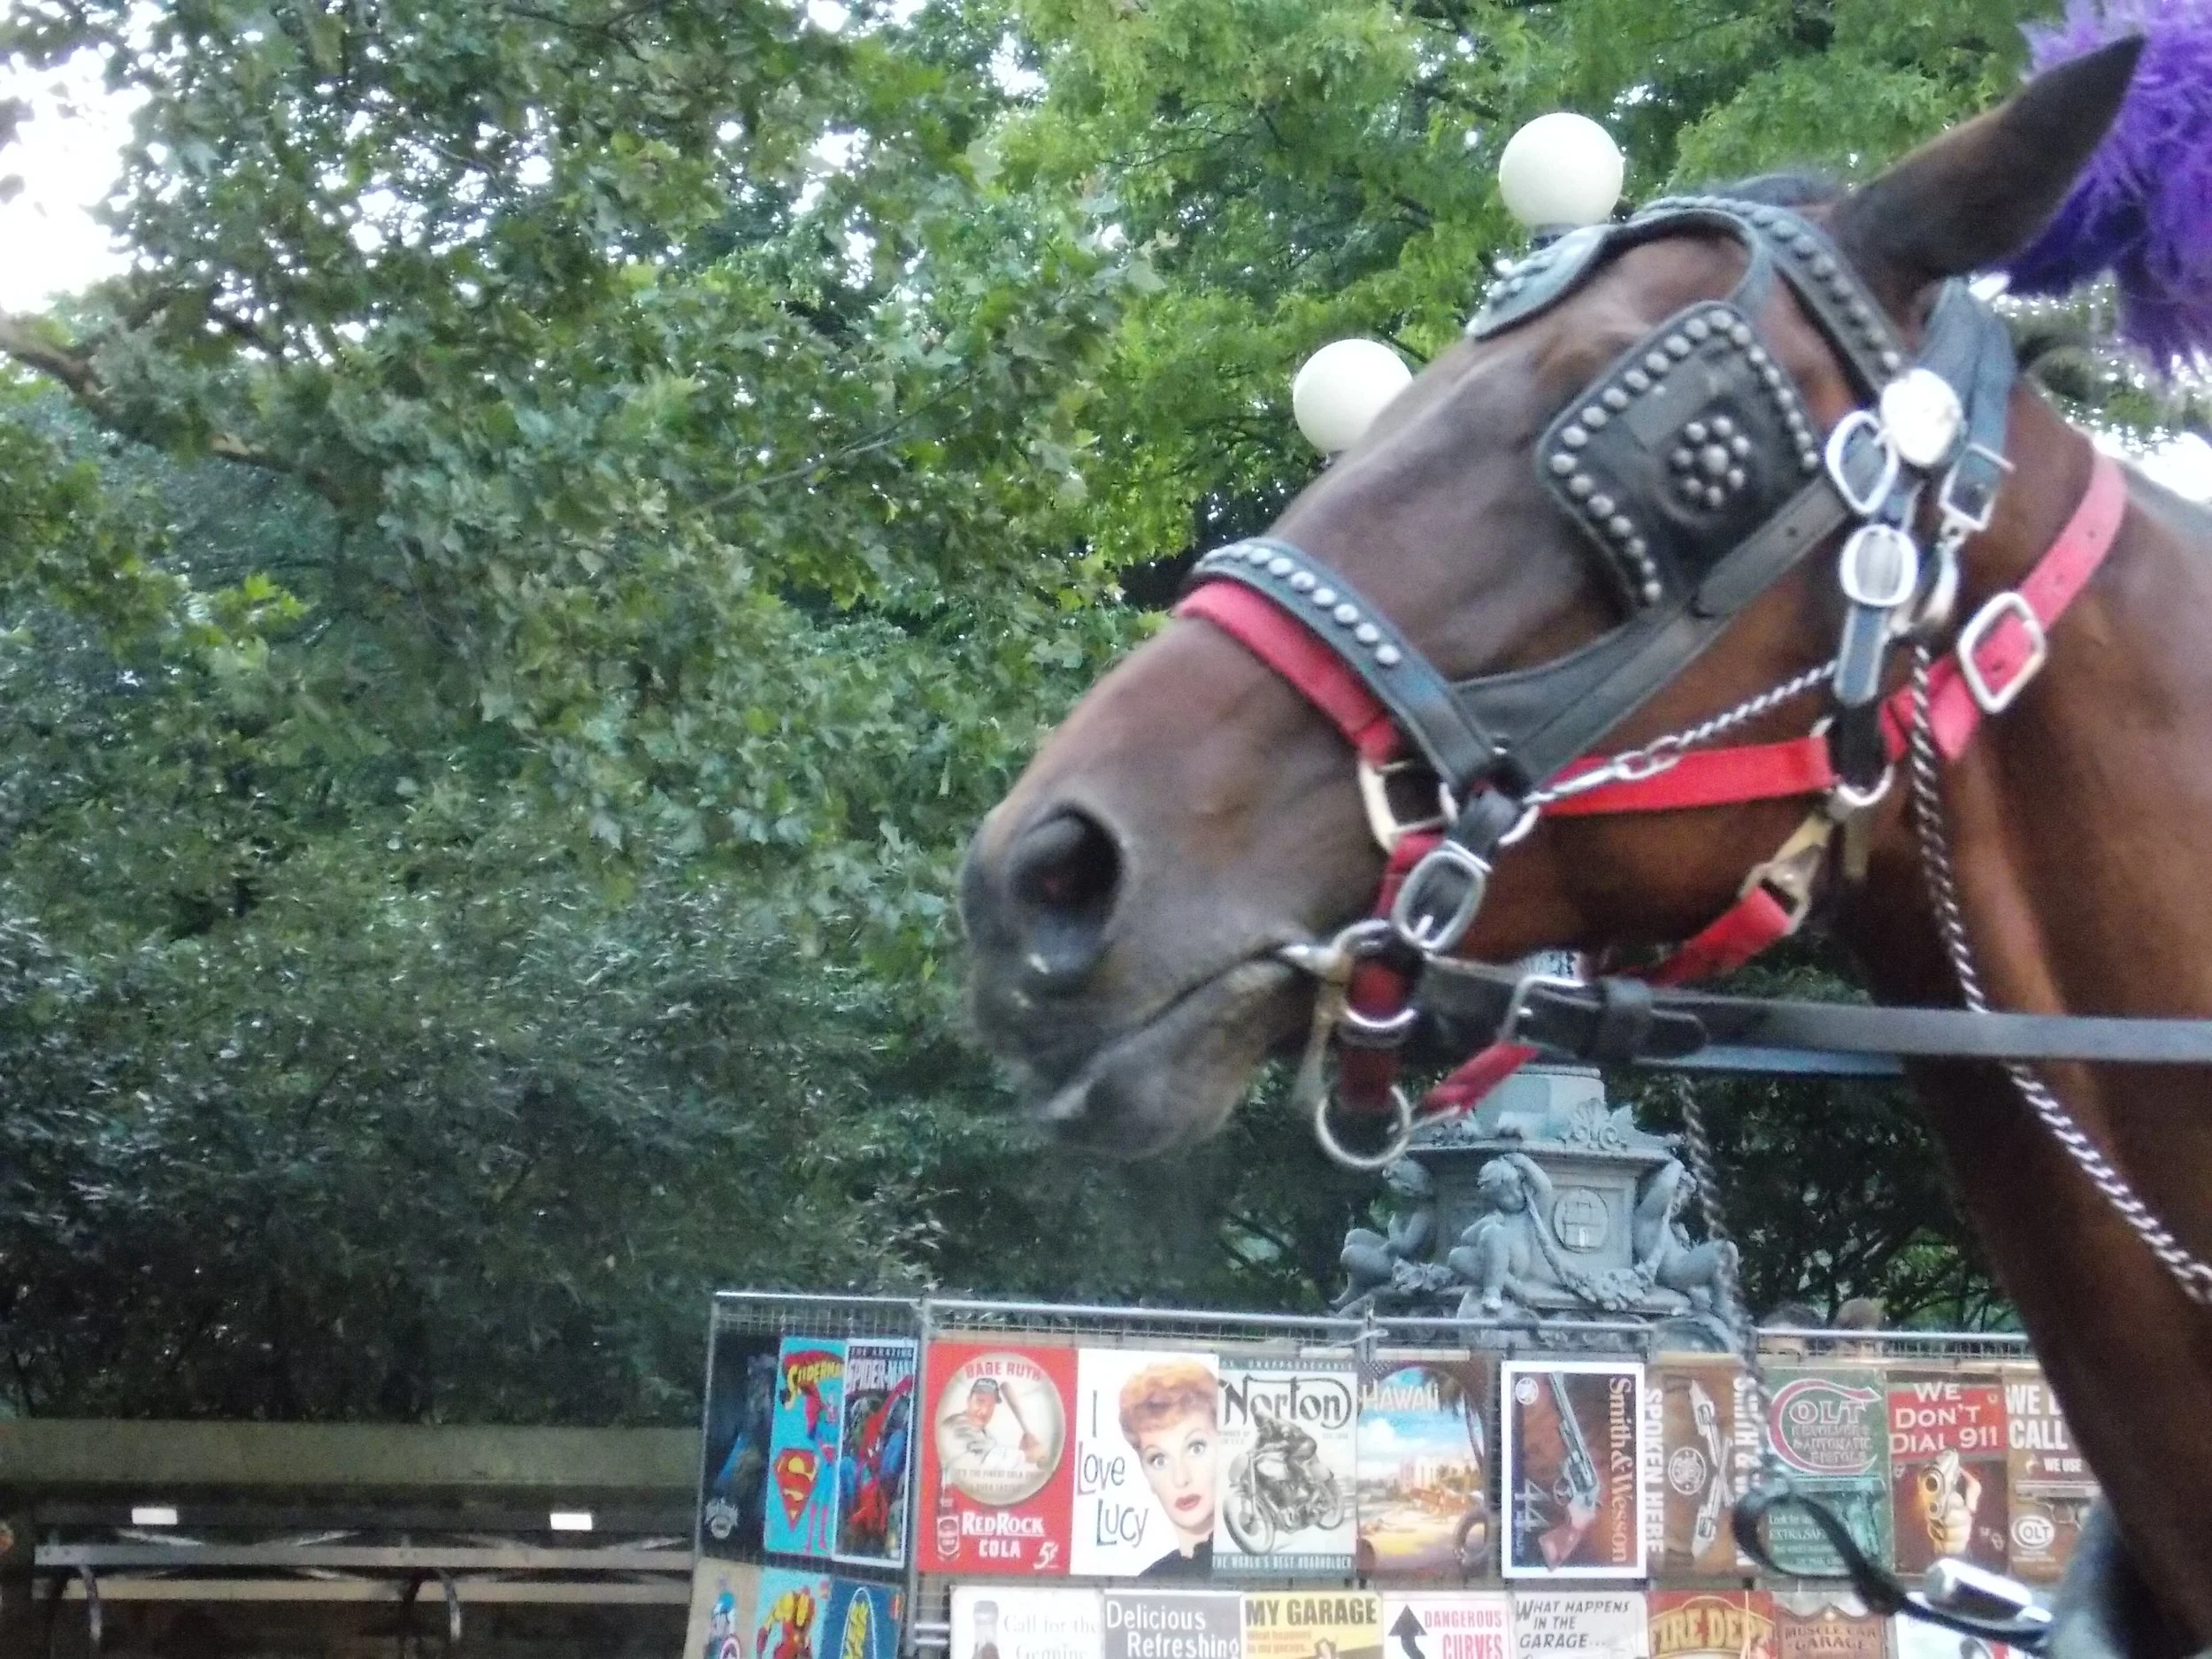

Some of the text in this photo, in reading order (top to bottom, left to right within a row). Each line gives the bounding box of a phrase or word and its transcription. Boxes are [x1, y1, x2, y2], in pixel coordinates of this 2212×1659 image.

[965, 1362, 1041, 1381] BABE RUTH
[1218, 1373, 1352, 1430] Norton
[1358, 1379, 1440, 1412] HAWAII
[1914, 1381, 1962, 1403] WE
[2006, 1384, 2040, 1416] WE
[1092, 1390, 1098, 1438] I
[1894, 1403, 1981, 1429] DON'T
[1888, 1425, 1998, 1455] DIAL 911
[2008, 1419, 2069, 1451] CALL
[1077, 1440, 1125, 1495] Love
[1645, 1388, 1664, 1553] SPOKEN HERE
[2043, 1458, 2082, 1472] WE USE
[1096, 1498, 1149, 1548] Lucy
[979, 1540, 1021, 1558] COLA
[1003, 1614, 1097, 1634] Call for the
[1106, 1600, 1206, 1631] Delicious
[1245, 1597, 1377, 1627] MY GARAGE
[1424, 1610, 1502, 1628] DANGEROUS
[1516, 1599, 1631, 1621] WHAT HAPPENS
[1533, 1616, 1577, 1630] IN THE
[1127, 1631, 1240, 1659] Refreshing
[1785, 1626, 1839, 1639] MUSCLE
[1794, 1636, 1864, 1652] GARAGE
